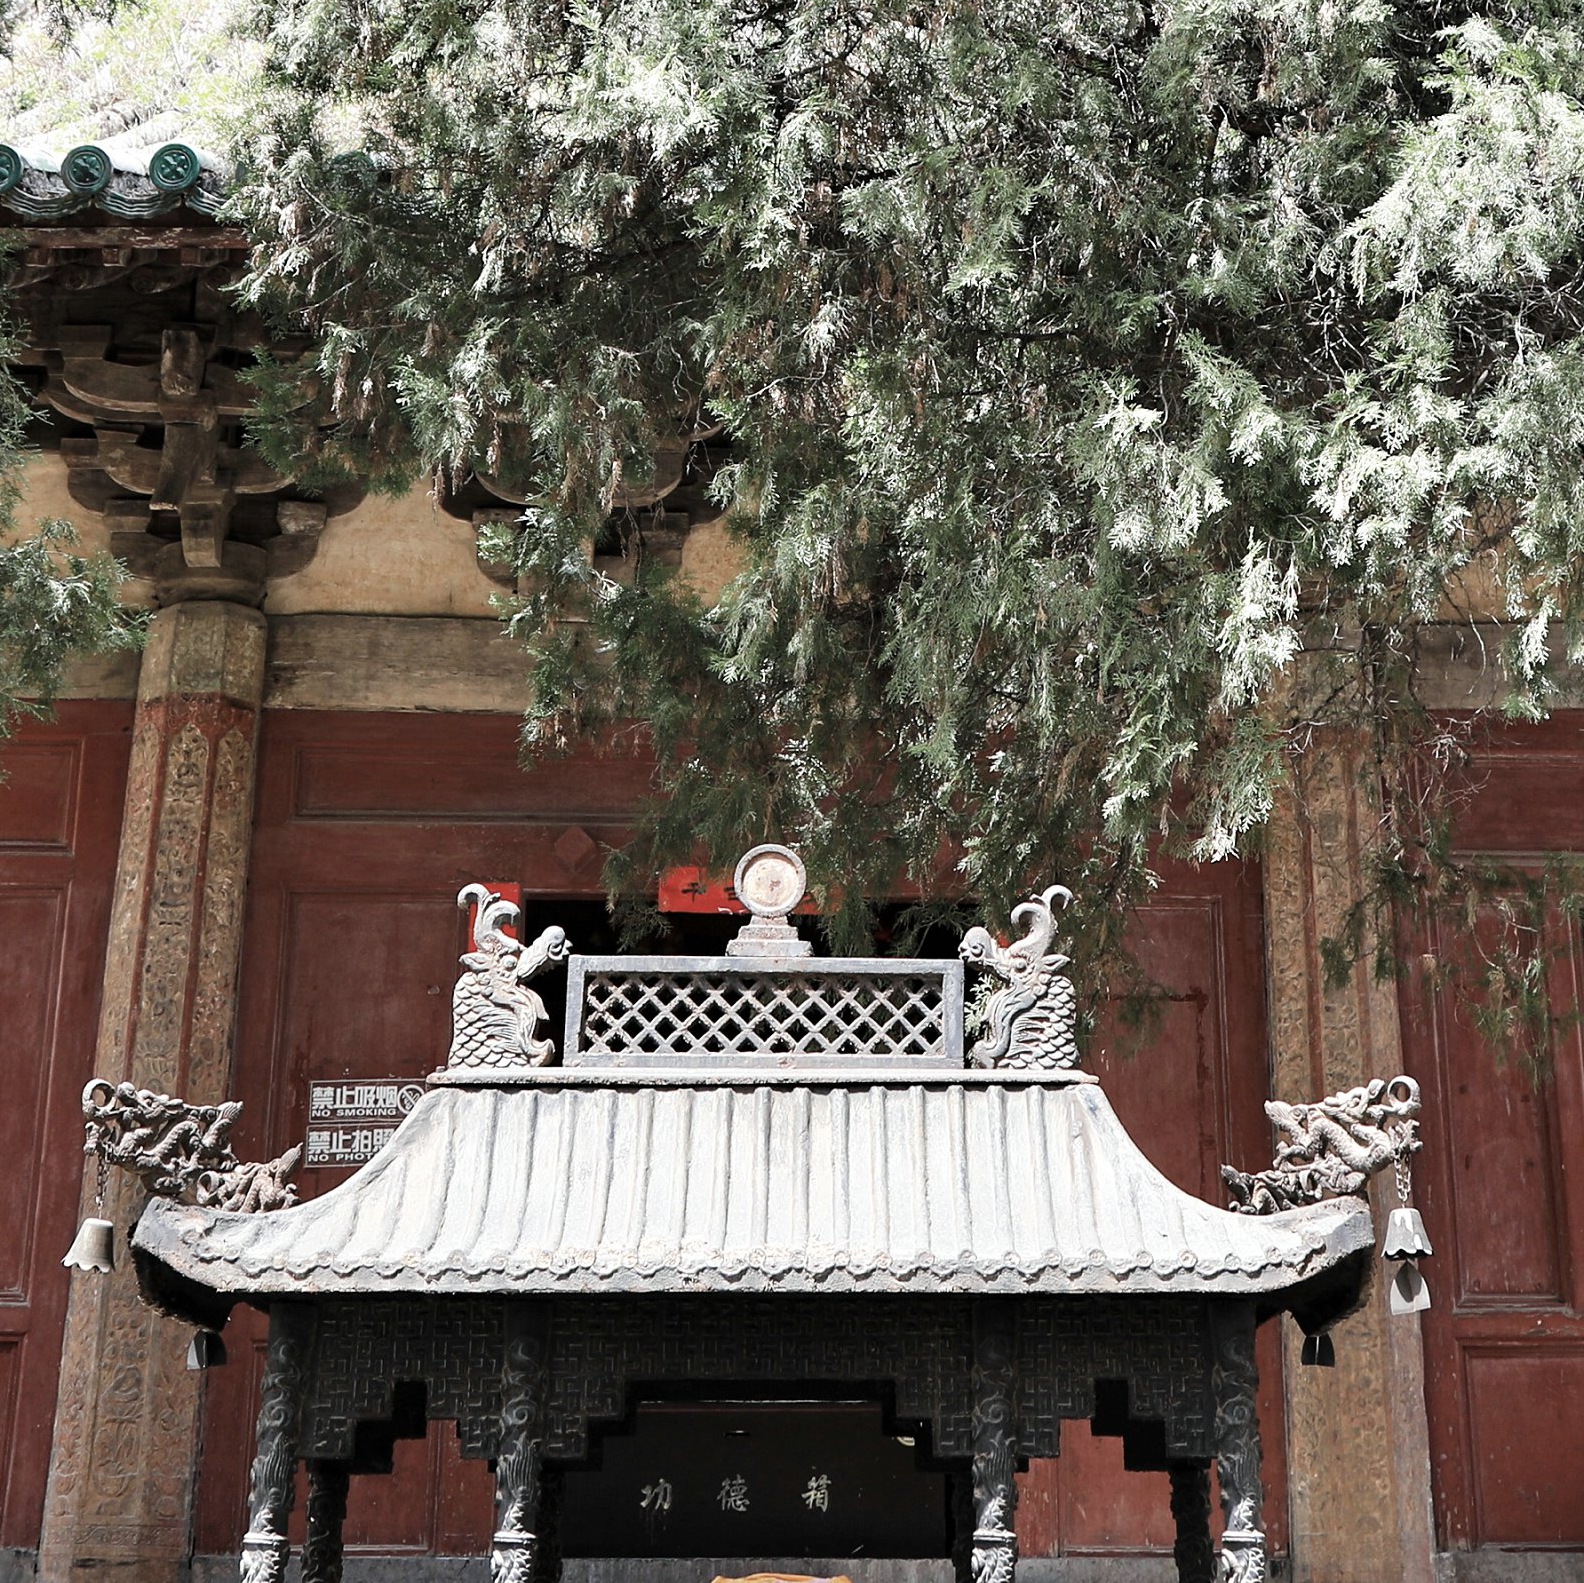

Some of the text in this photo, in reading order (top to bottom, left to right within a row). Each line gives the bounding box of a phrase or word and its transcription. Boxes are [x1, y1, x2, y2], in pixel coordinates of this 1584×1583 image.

[312, 1085, 398, 1109] 禁止吸烟
[311, 1108, 397, 1117] NO SMOKING
[308, 1152, 378, 1162] NO PHOT
